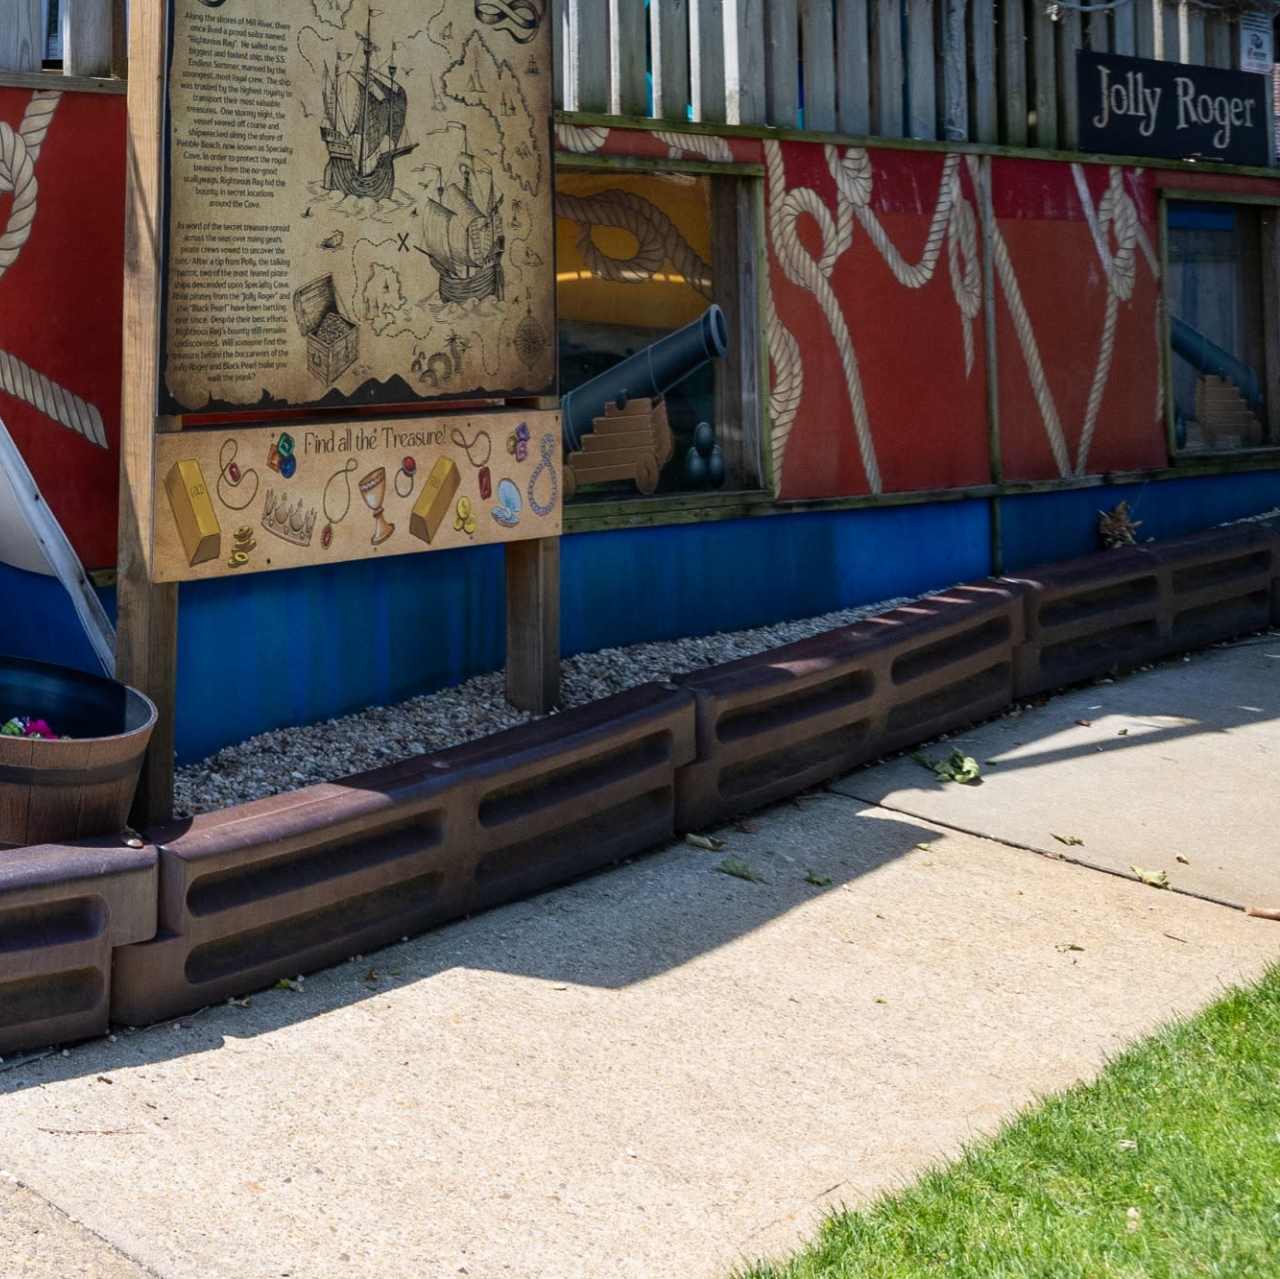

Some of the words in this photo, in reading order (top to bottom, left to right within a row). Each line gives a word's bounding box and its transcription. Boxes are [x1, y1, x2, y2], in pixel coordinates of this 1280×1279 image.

[1093, 65, 1162, 136] Jolly
[1174, 77, 1256, 149] Roger
[304, 430, 334, 455] Find
[338, 429, 351, 452] all
[356, 428, 376, 451] the
[382, 424, 446, 449] Treasure!
